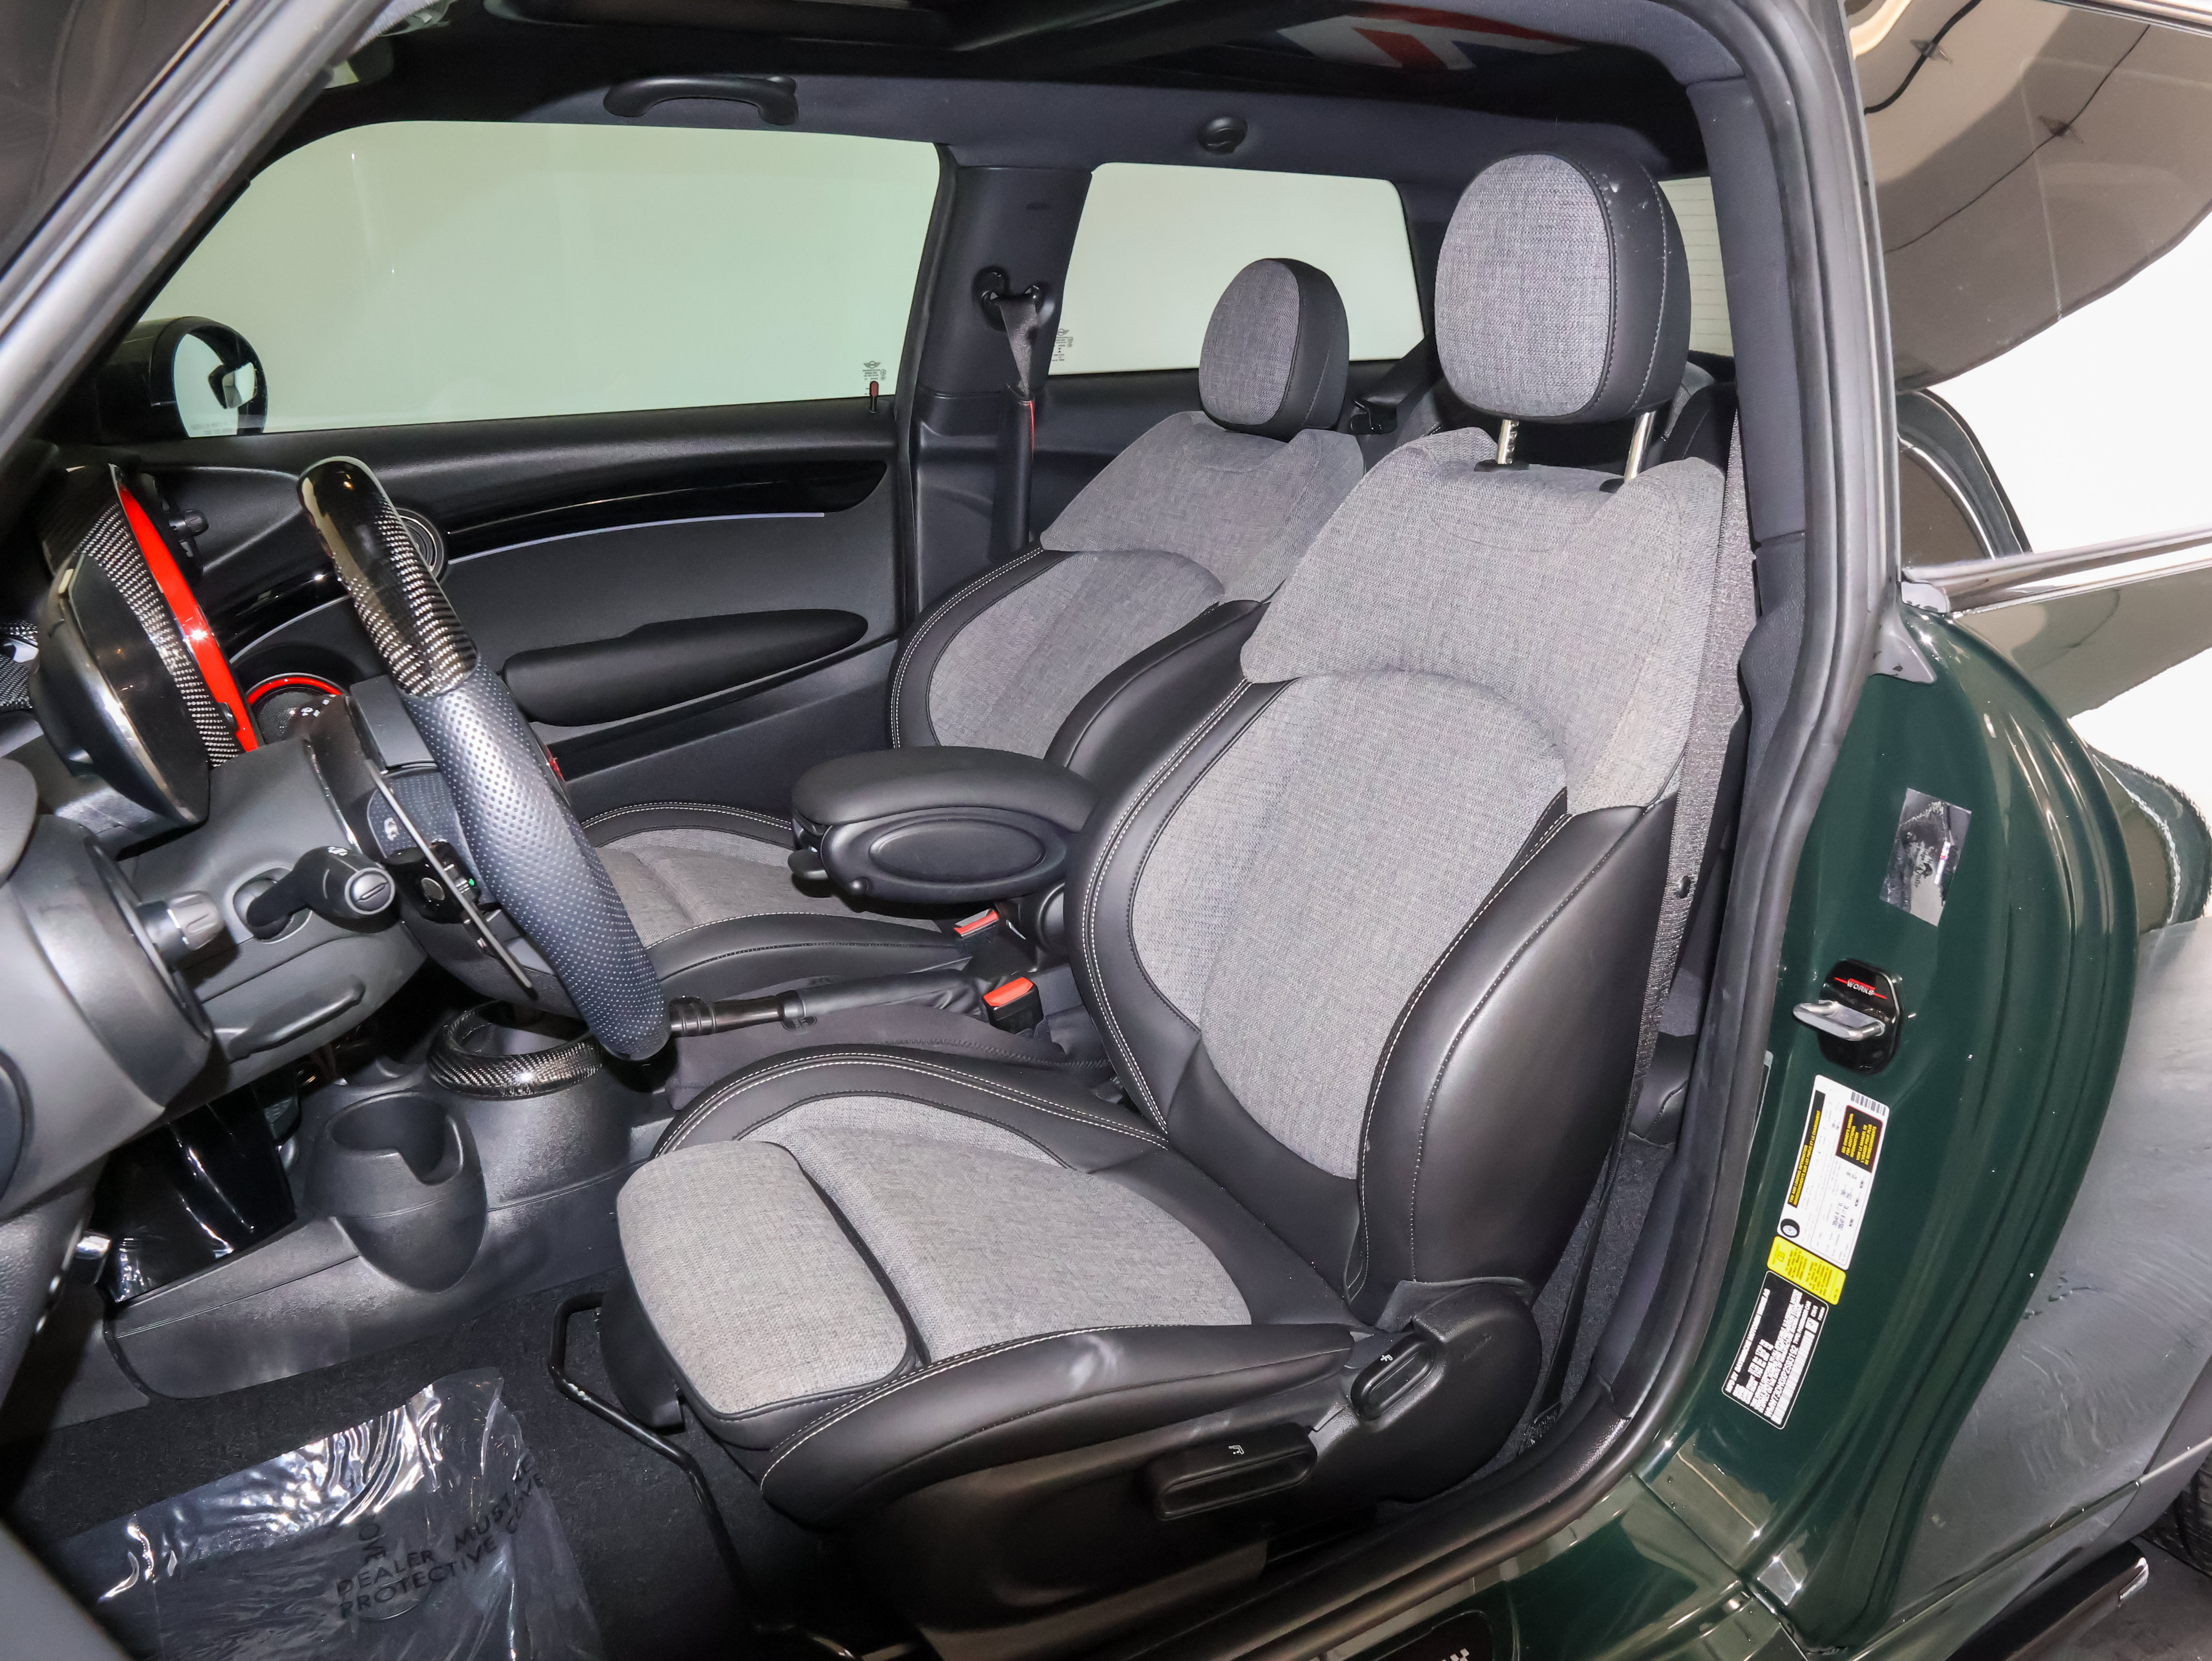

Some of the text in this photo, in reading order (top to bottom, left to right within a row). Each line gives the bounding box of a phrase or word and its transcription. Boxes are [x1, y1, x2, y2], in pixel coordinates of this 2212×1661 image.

[1847, 980, 1874, 996] WORKS
[1798, 1145, 1808, 1170] INFORMATION
[1850, 1132, 1859, 1157] INFORMATION
[1730, 1371, 1738, 1381] BY
[1763, 1289, 1770, 1298] AG
[336, 1549, 435, 1596] DEALER
[455, 1492, 511, 1551] MUST
[338, 1536, 497, 1618] PROTECTIVE
